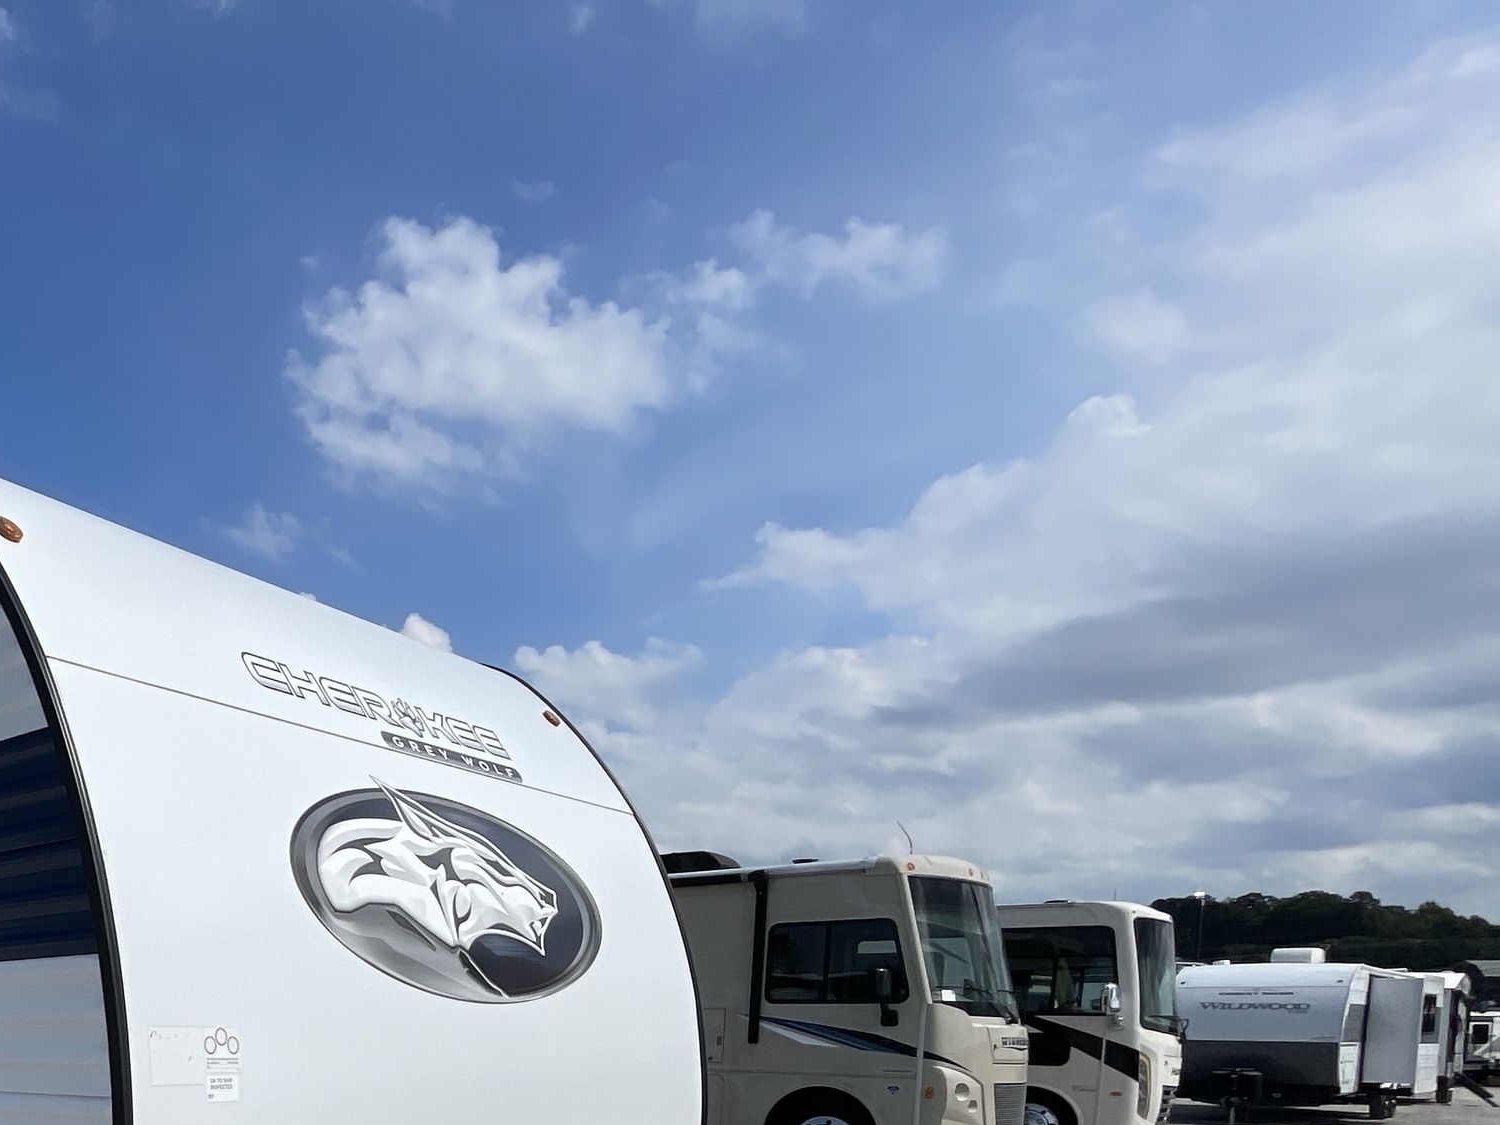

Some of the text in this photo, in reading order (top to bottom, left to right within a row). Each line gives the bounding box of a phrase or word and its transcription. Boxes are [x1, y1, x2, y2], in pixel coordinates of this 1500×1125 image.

[390, 735, 516, 779] GREY WOLF
[1200, 1001, 1310, 1011] WILDWOOD
